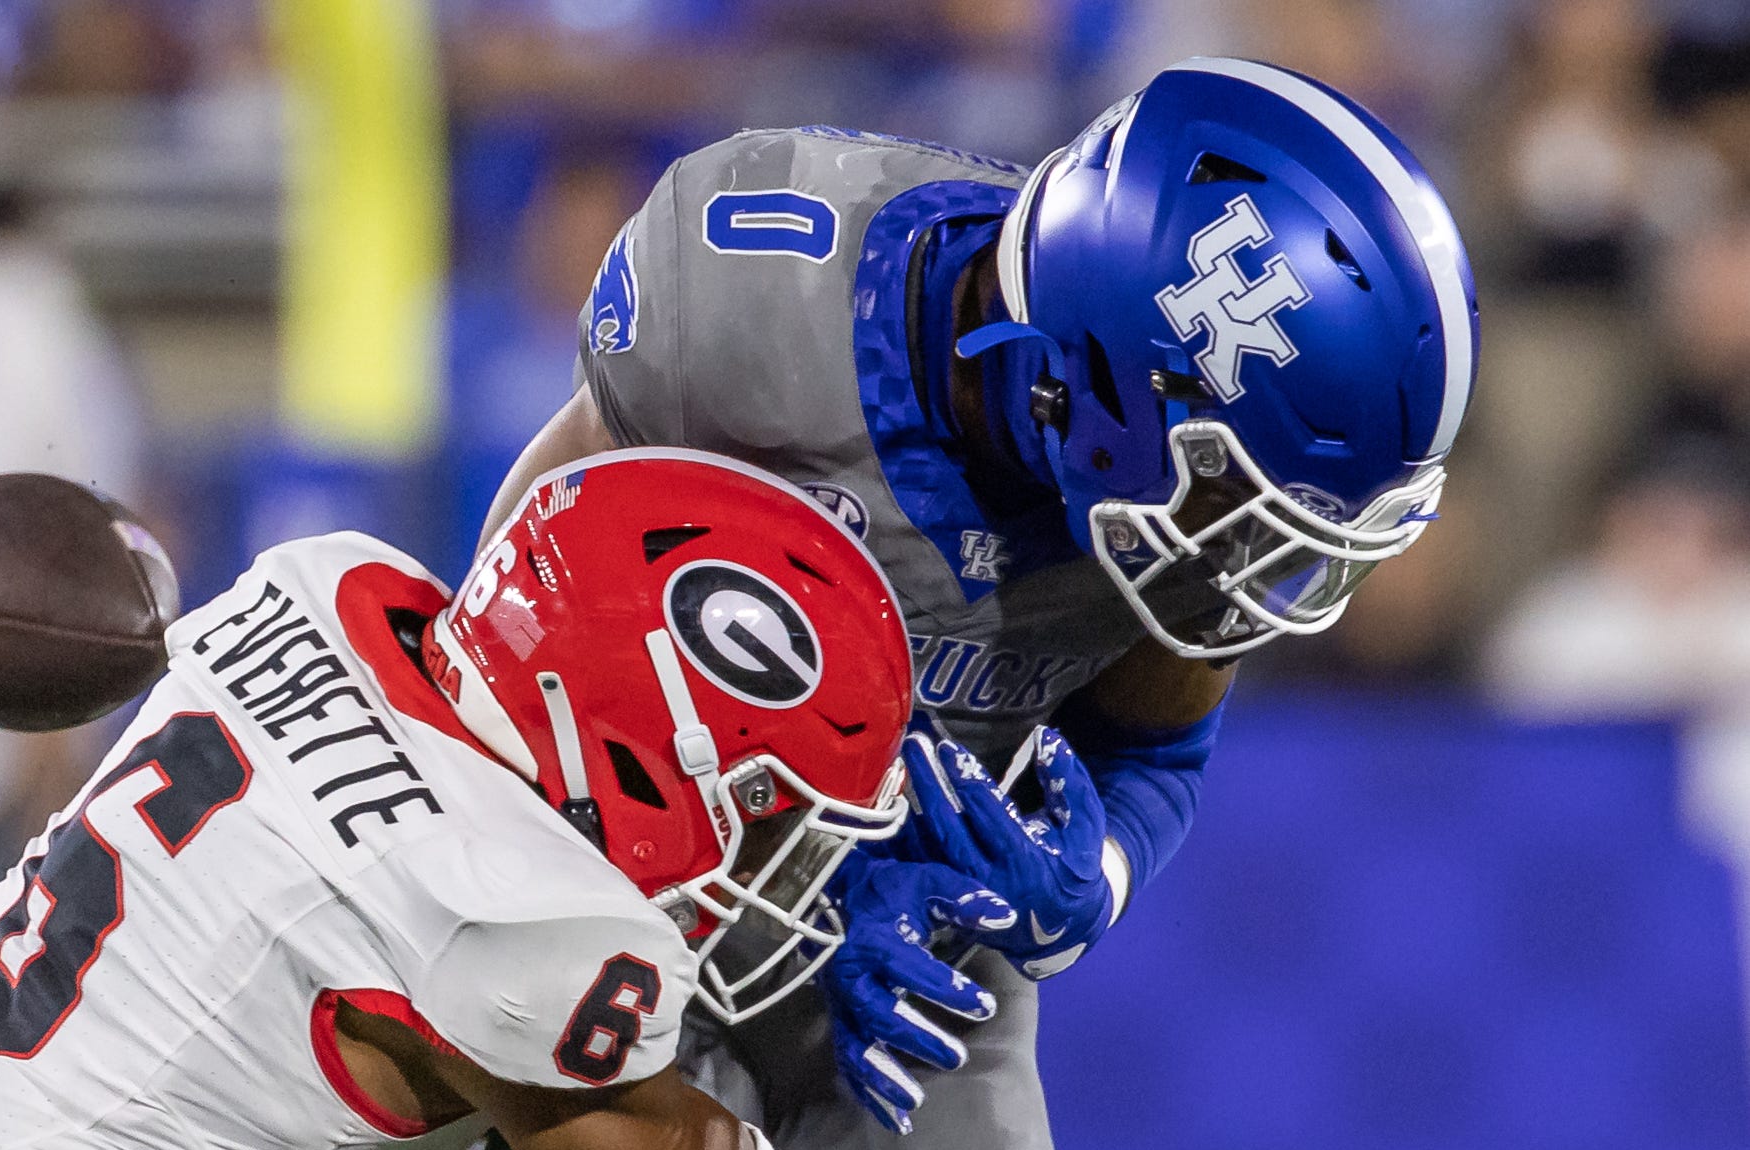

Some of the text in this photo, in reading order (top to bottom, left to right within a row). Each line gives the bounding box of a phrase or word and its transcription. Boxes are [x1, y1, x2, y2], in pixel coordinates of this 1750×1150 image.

[702, 189, 840, 265] 0
[464, 539, 517, 618] 6
[663, 559, 823, 709] G
[908, 634, 1102, 711] UCK
[191, 581, 444, 848] EVERETTE
[553, 952, 662, 1085] 6
